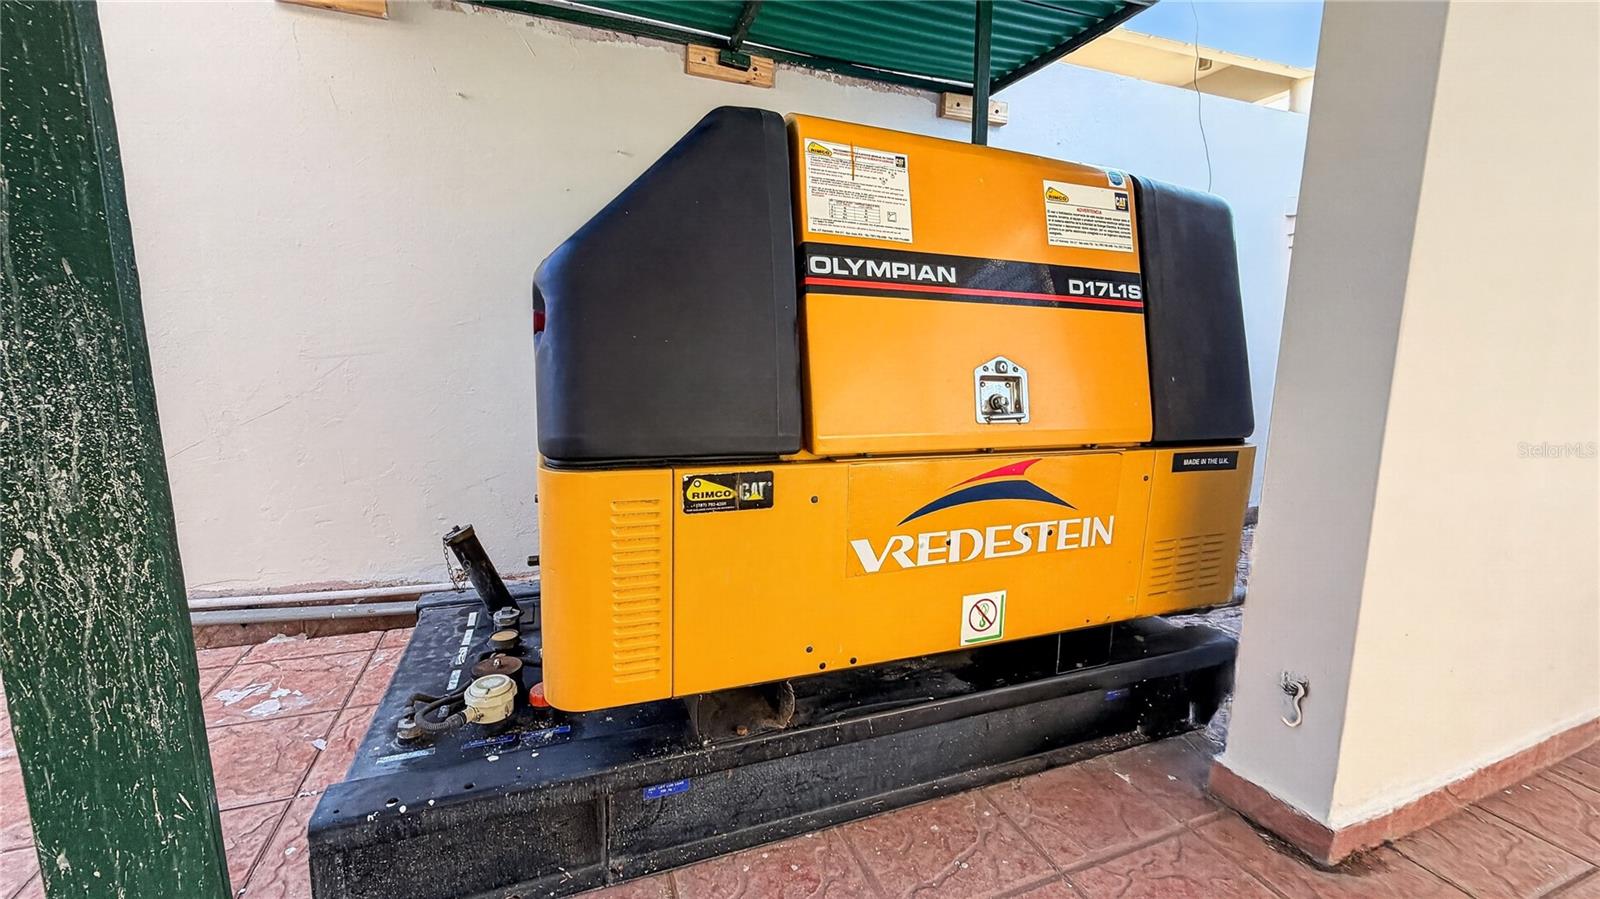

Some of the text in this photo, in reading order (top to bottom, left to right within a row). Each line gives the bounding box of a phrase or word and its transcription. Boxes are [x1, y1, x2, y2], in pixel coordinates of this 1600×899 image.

[1048, 194, 1067, 202] RIMCO
[809, 256, 957, 284] OLYMPIAN
[1069, 279, 1142, 299] D17L1S
[1183, 458, 1200, 466] MADE
[1207, 457, 1218, 465] THE
[692, 490, 731, 499] RIMCO
[740, 481, 767, 501] CAT
[850, 515, 1115, 574] VREDESTEIN
